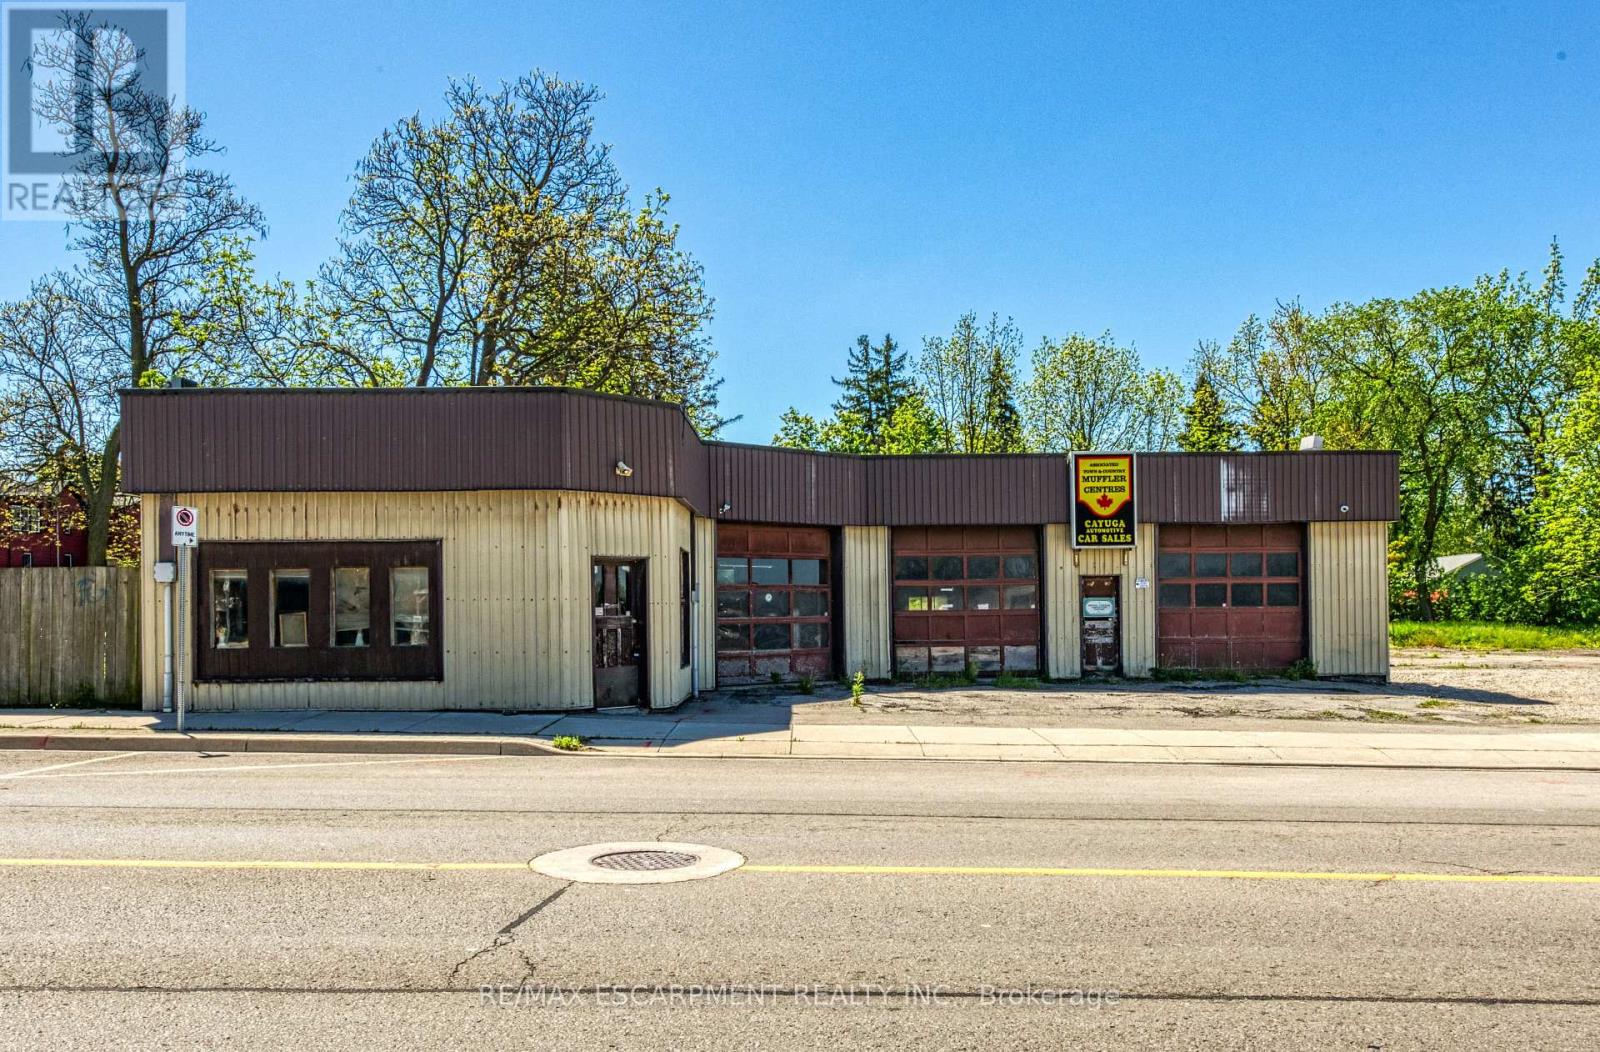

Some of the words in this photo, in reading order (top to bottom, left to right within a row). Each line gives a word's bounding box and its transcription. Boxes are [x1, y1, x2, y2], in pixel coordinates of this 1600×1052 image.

[1082, 475, 1127, 483] MUFFLER
[1083, 485, 1126, 493] CENTRES
[1084, 519, 1126, 528] CAYUGA
[1078, 534, 1098, 543] CAR
[1101, 534, 1132, 543] SALES
